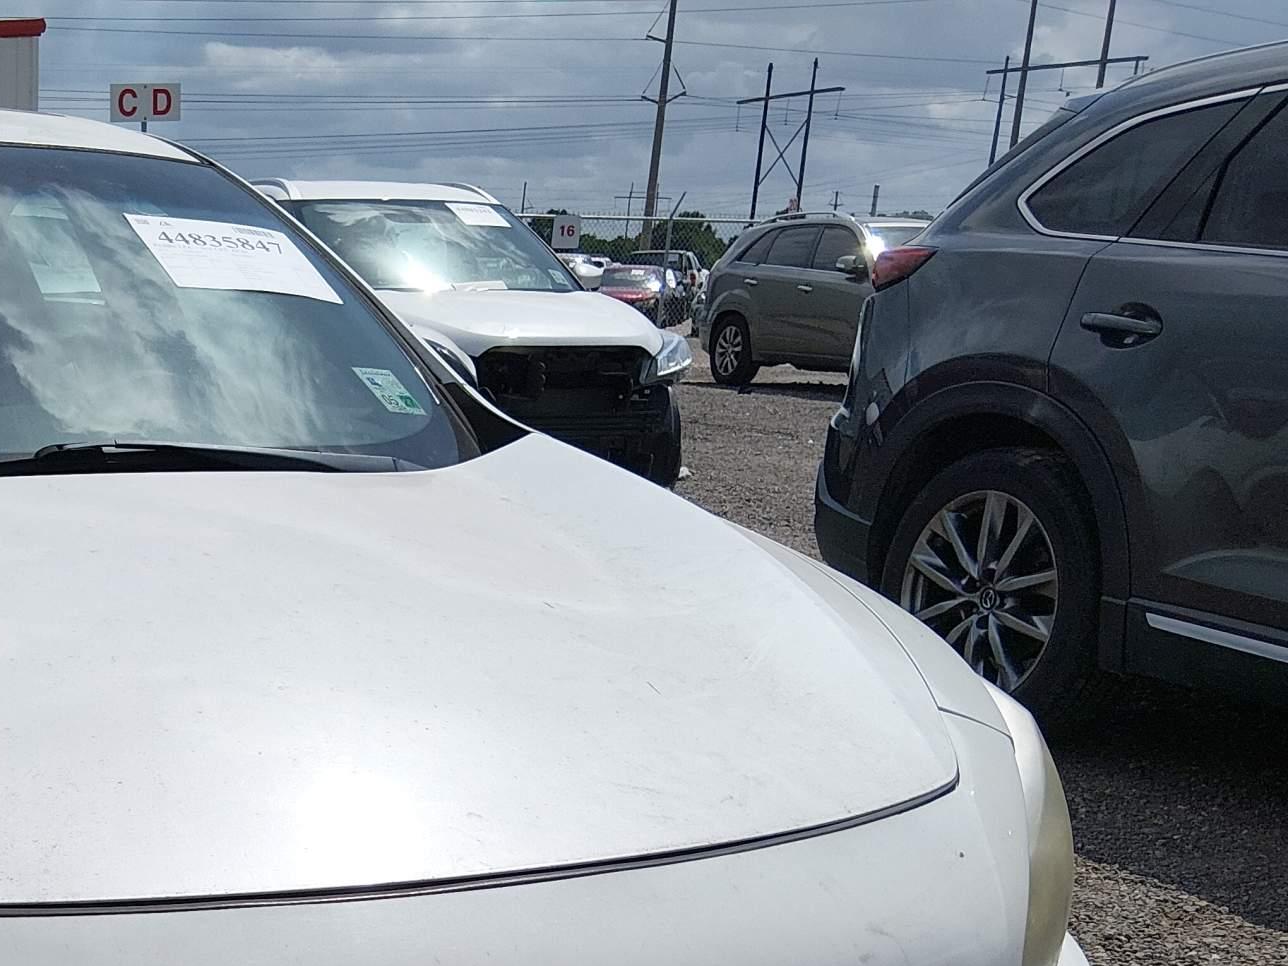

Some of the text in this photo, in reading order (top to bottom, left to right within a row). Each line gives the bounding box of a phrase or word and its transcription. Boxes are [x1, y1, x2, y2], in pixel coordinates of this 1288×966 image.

[118, 88, 172, 117] C D
[158, 231, 283, 255] 44835847
[559, 225, 575, 237] 16
